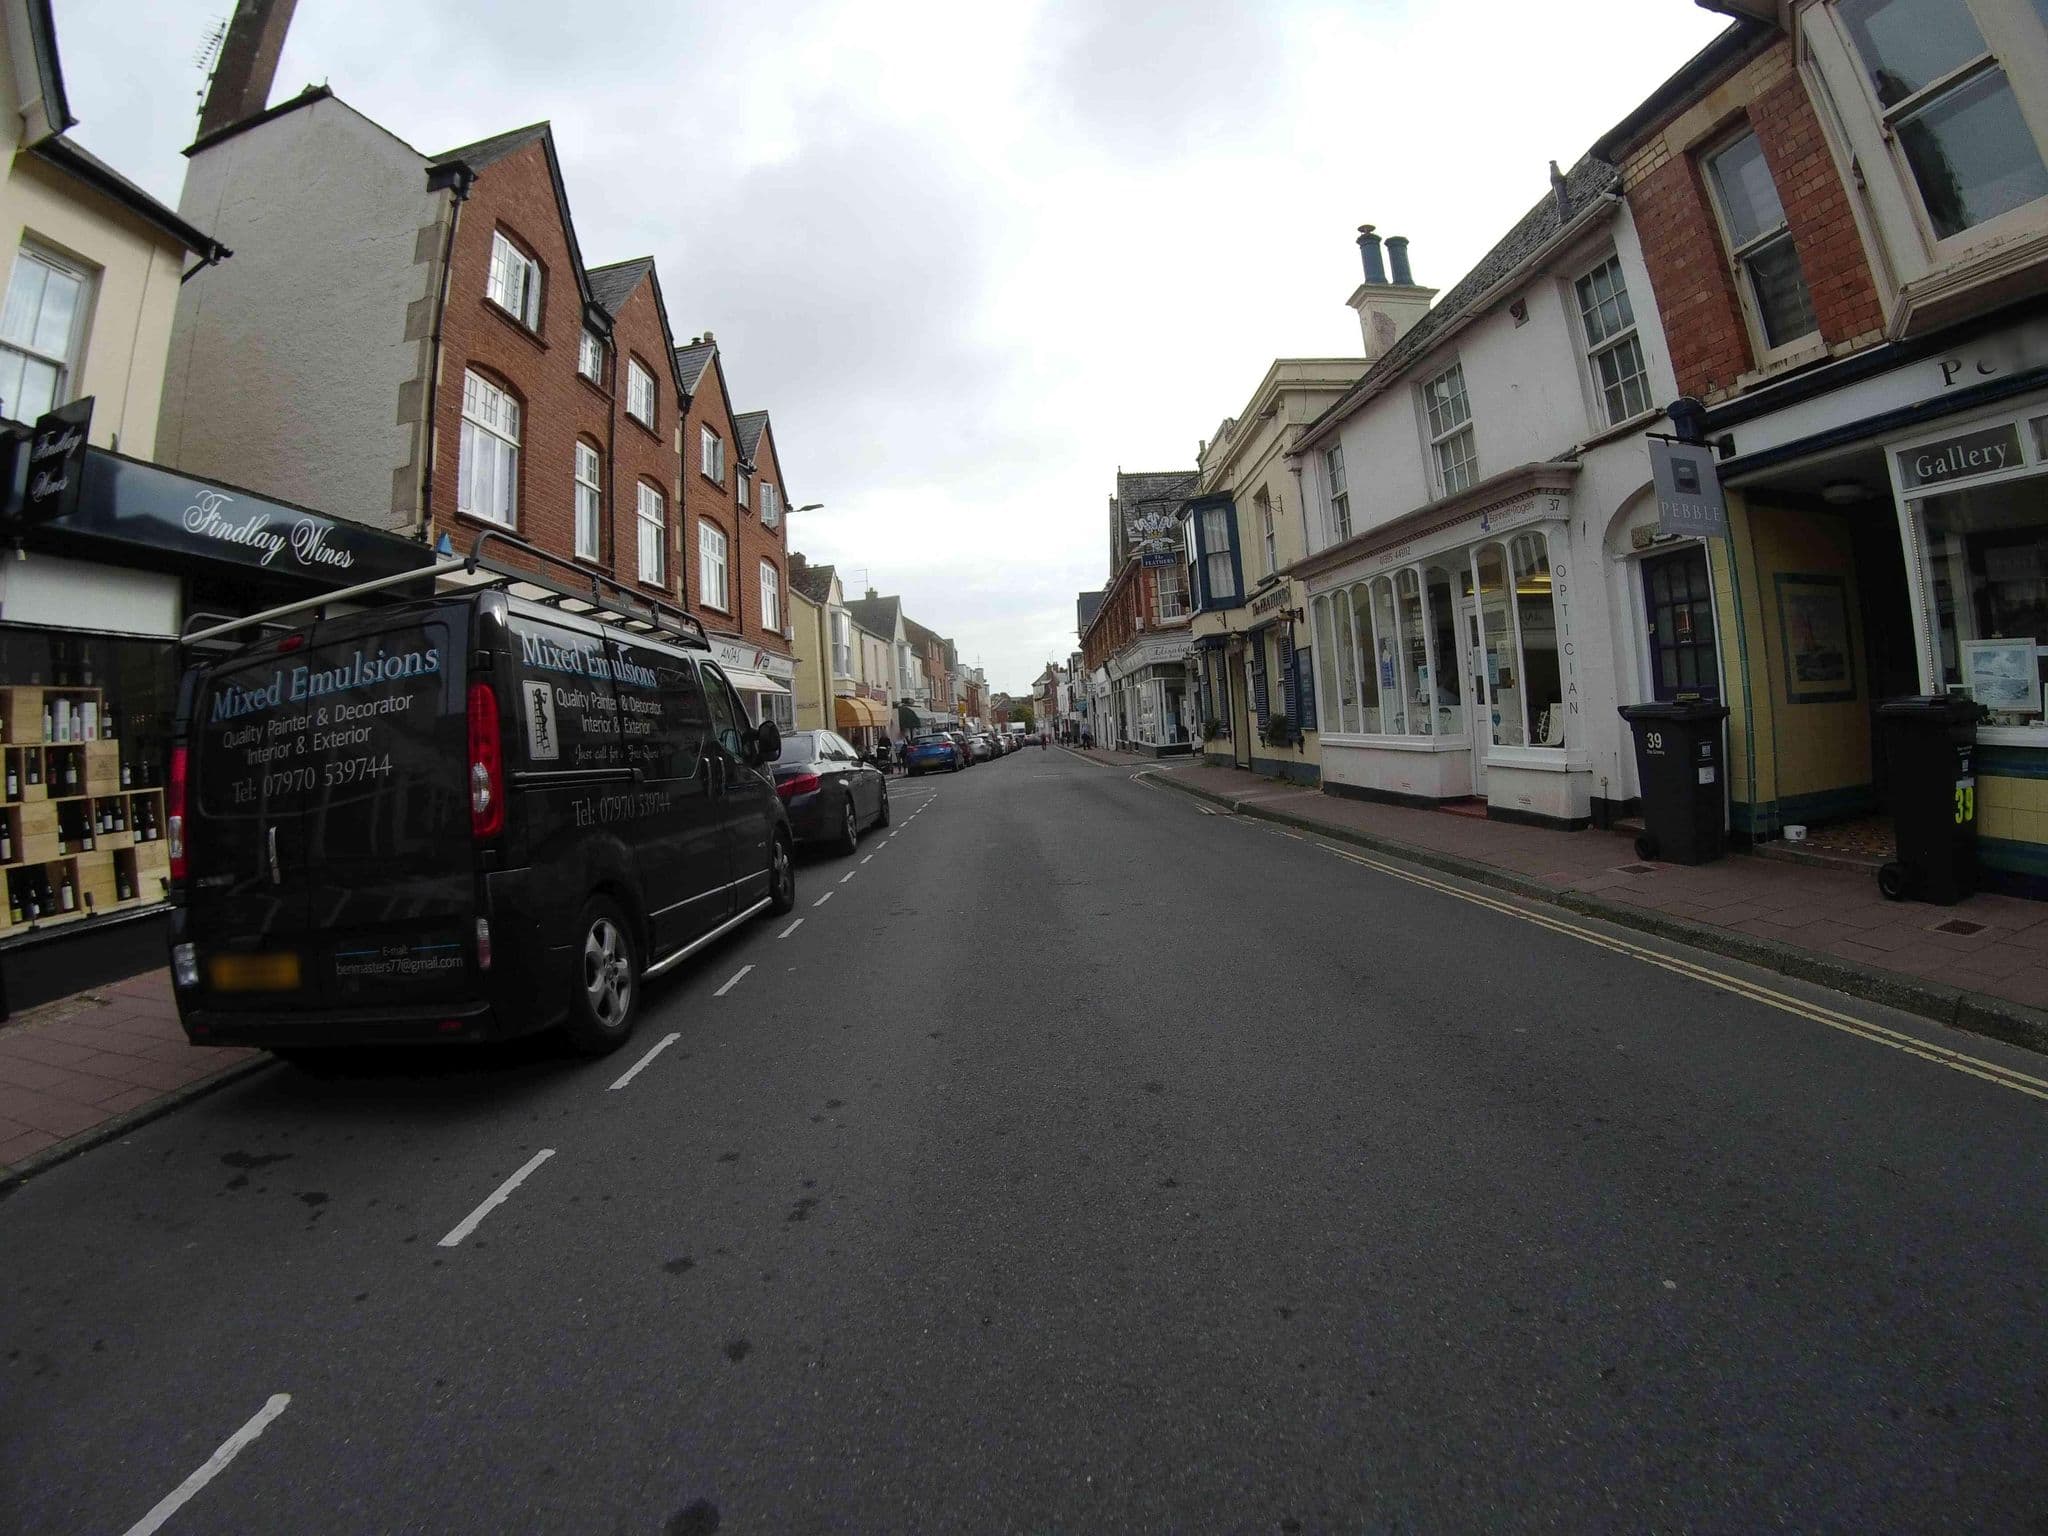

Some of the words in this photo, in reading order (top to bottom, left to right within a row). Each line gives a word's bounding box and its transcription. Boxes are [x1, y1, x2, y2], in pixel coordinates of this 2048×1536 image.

[32, 427, 82, 462] Findlay
[1915, 441, 2008, 478] Gallery
[31, 467, 69, 503] Wines
[1548, 498, 1560, 511] 37
[1661, 501, 1721, 521] PEBBLE
[183, 489, 287, 567] Findlay
[291, 518, 355, 569] Wines
[1145, 558, 1174, 566] FEATHERS
[1555, 564, 1579, 715] OPTICIAN
[520, 632, 583, 674] Mixed
[585, 646, 658, 688] Emulsions
[210, 671, 281, 723] Mixed
[289, 648, 441, 702] Emulsions
[556, 687, 589, 712] Quality
[591, 691, 618, 711] Painter
[621, 694, 628, 710] &
[630, 696, 663, 715] Decorator
[223, 724, 263, 749] Quality
[267, 714, 311, 738] Painter
[316, 708, 328, 726] &
[335, 693, 414, 722] Decorator
[582, 714, 611, 733] Interior
[613, 718, 620, 733] &
[624, 720, 651, 736] Exterior
[247, 742, 290, 765] Interior
[296, 736, 307, 755] &
[314, 725, 372, 751] Exterior
[575, 744, 592, 765] Just
[1647, 732, 1662, 749] 39
[232, 781, 257, 804] Tel:
[263, 767, 316, 798] 07970
[324, 753, 393, 787] 539744
[572, 797, 595, 827] Tel:
[600, 795, 635, 822] 07970
[1954, 786, 1974, 824] 39
